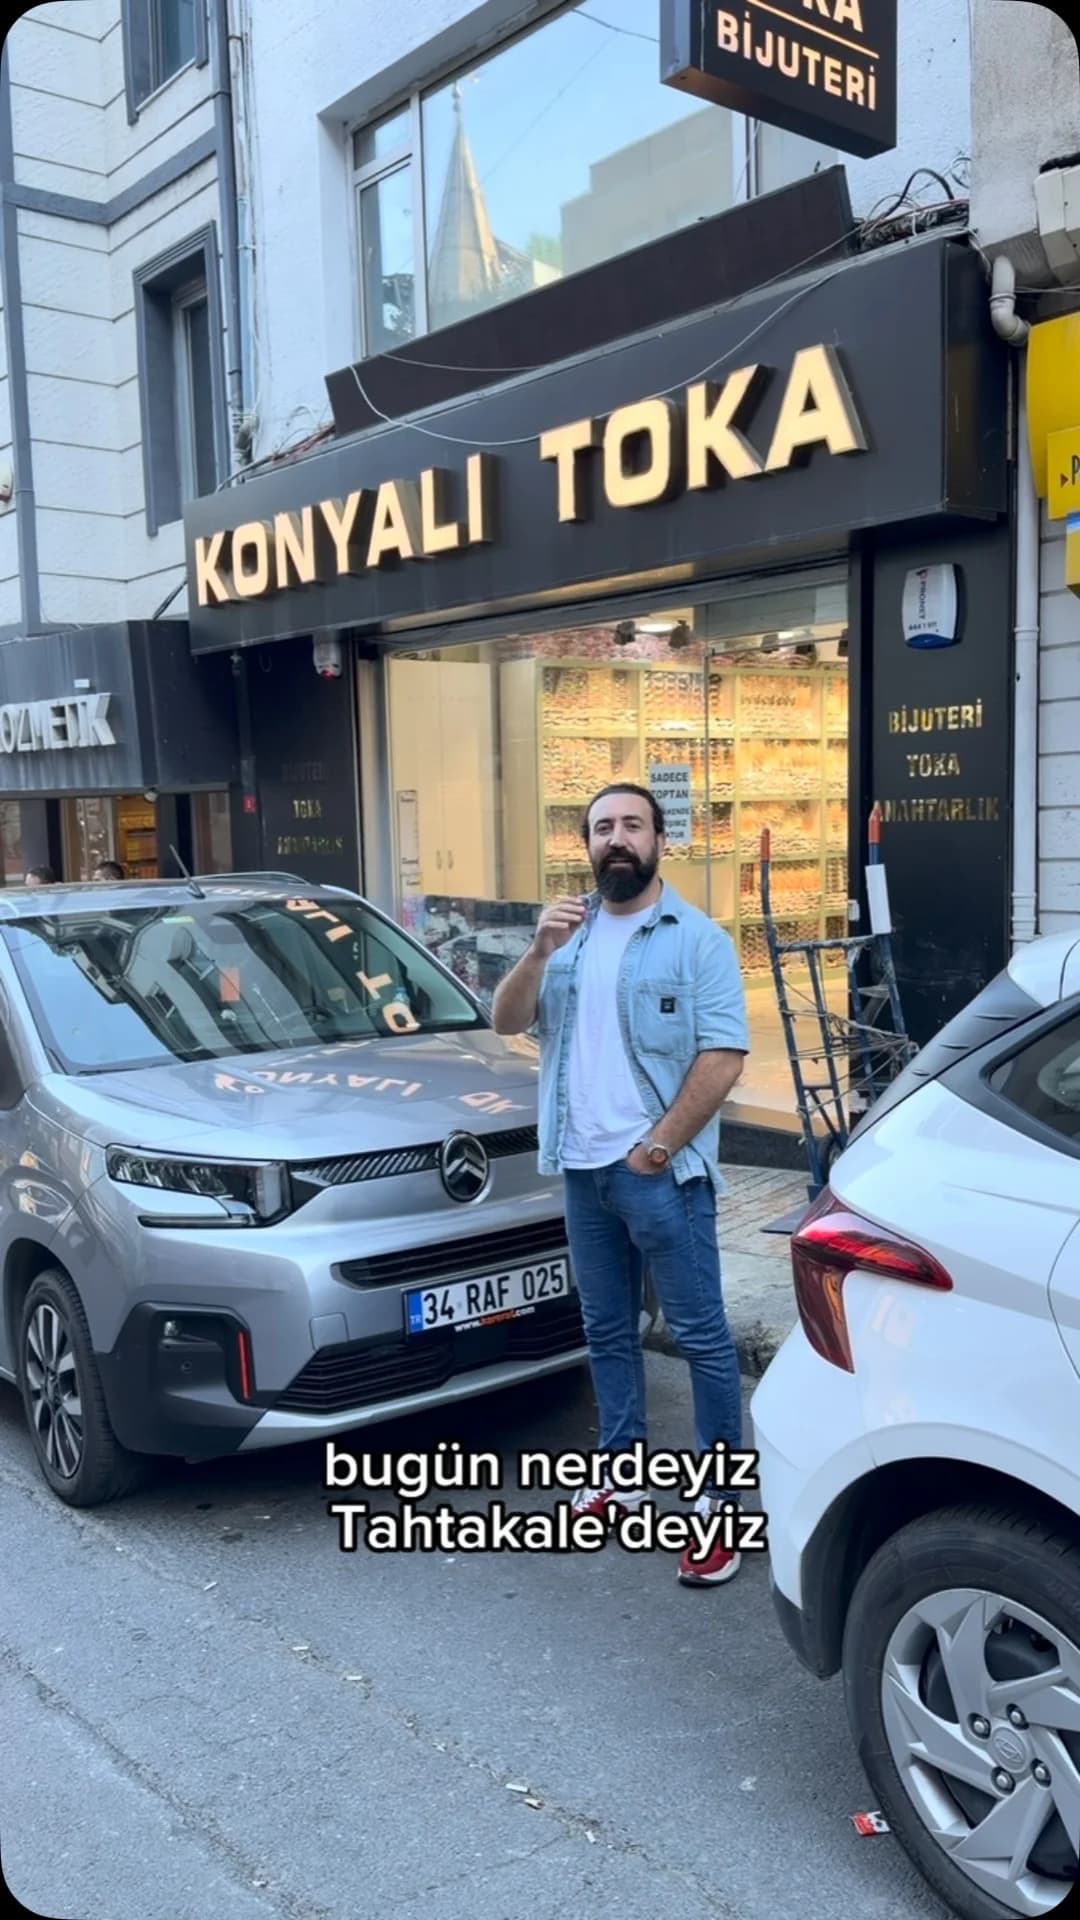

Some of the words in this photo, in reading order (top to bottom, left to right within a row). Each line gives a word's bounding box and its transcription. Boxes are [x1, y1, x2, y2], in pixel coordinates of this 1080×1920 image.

[717, 10, 876, 110] BİJUTERİ
[195, 451, 493, 606] KONYALI
[539, 342, 866, 523] TOKA
[0, 678, 116, 754] OZMETİK
[888, 698, 983, 734] BİJUTERİ
[650, 772, 689, 783] SADECE
[906, 753, 961, 777] TOKA
[424, 1290, 455, 1325] 34
[466, 1275, 509, 1315] RAF
[522, 1263, 564, 1301] 025
